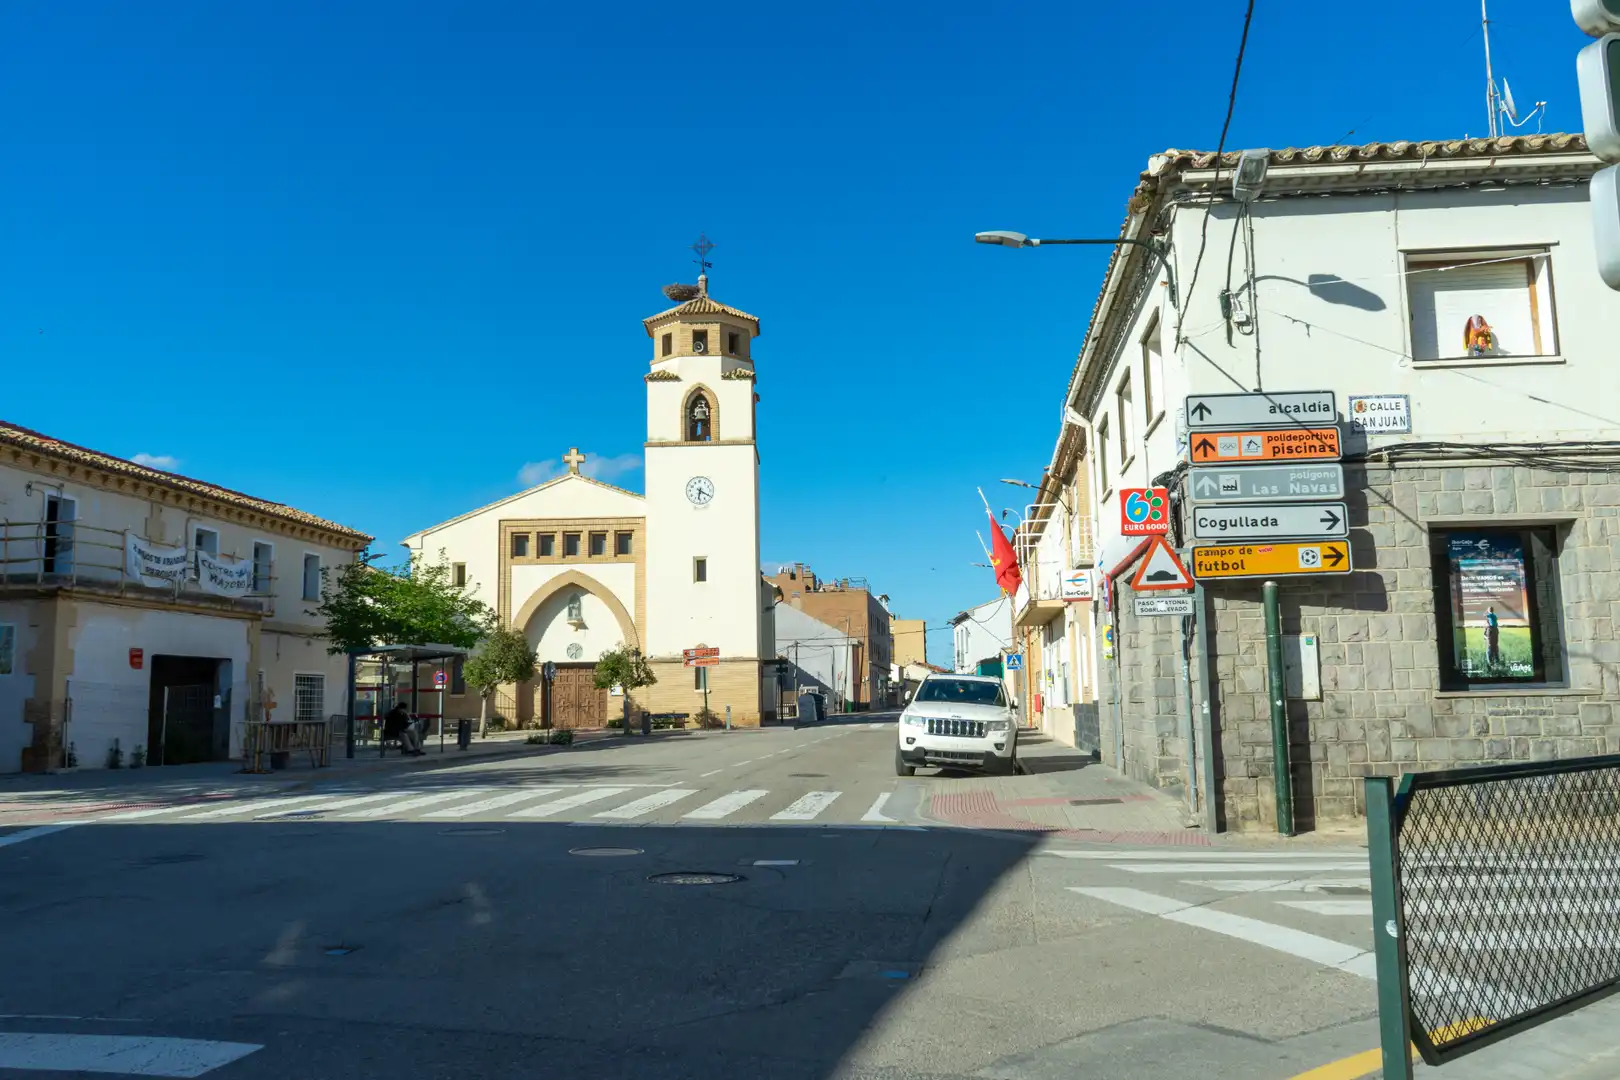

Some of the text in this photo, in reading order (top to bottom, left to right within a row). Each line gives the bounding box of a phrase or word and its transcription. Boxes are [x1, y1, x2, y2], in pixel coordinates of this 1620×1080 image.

[1269, 401, 1331, 414] alcaldía
[1369, 402, 1401, 411] CALLE
[1354, 415, 1406, 428] SAN JUAN
[1267, 432, 1335, 443] polideportivo
[1271, 443, 1336, 457] piscinas
[1289, 470, 1337, 482] polígono
[1252, 480, 1338, 495] Las Navas
[1124, 523, 1145, 531] EURO
[1198, 516, 1279, 531] Cogullada
[1197, 548, 1235, 559] campo
[1239, 546, 1253, 555] de
[1197, 559, 1246, 572] fútbol
